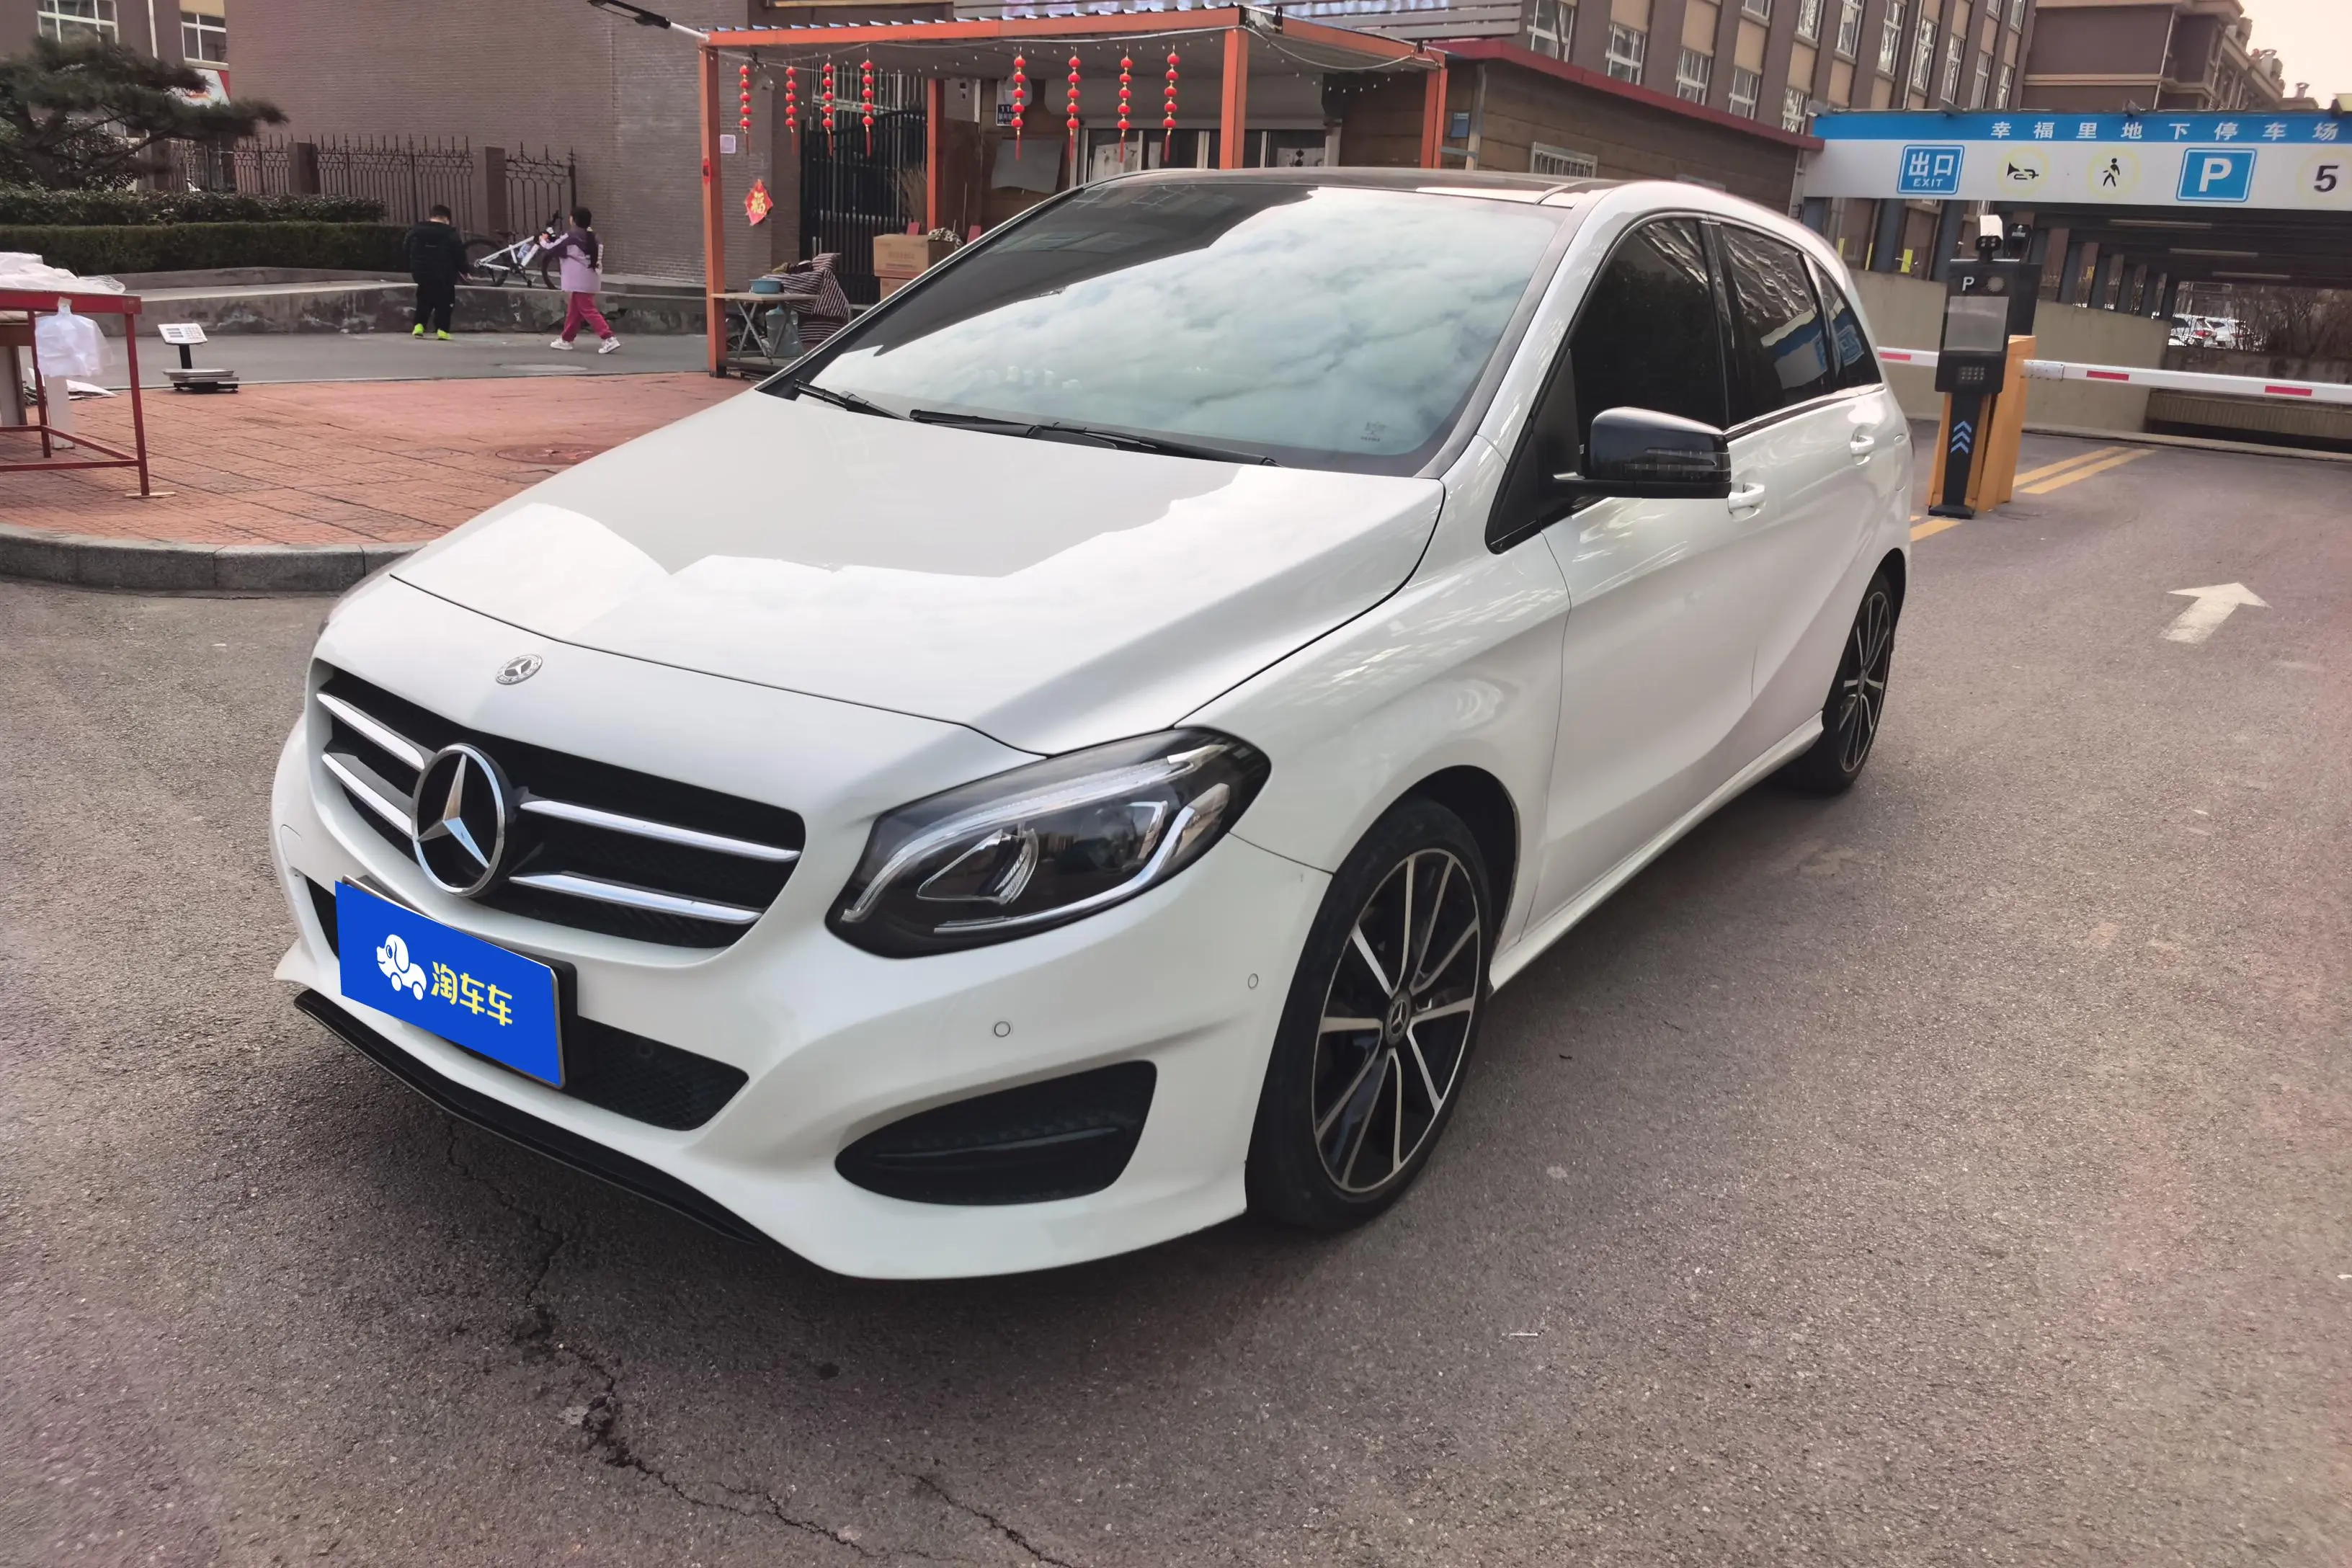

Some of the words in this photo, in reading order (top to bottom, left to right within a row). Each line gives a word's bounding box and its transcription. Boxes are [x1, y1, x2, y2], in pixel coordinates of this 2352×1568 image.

[1991, 121, 2339, 141] 幸福里地下停车场
[1908, 151, 1954, 177] 出口
[2199, 158, 2232, 192] P
[1913, 179, 1943, 187] EXIT
[2314, 165, 2339, 192] 5
[1962, 277, 1975, 291] P
